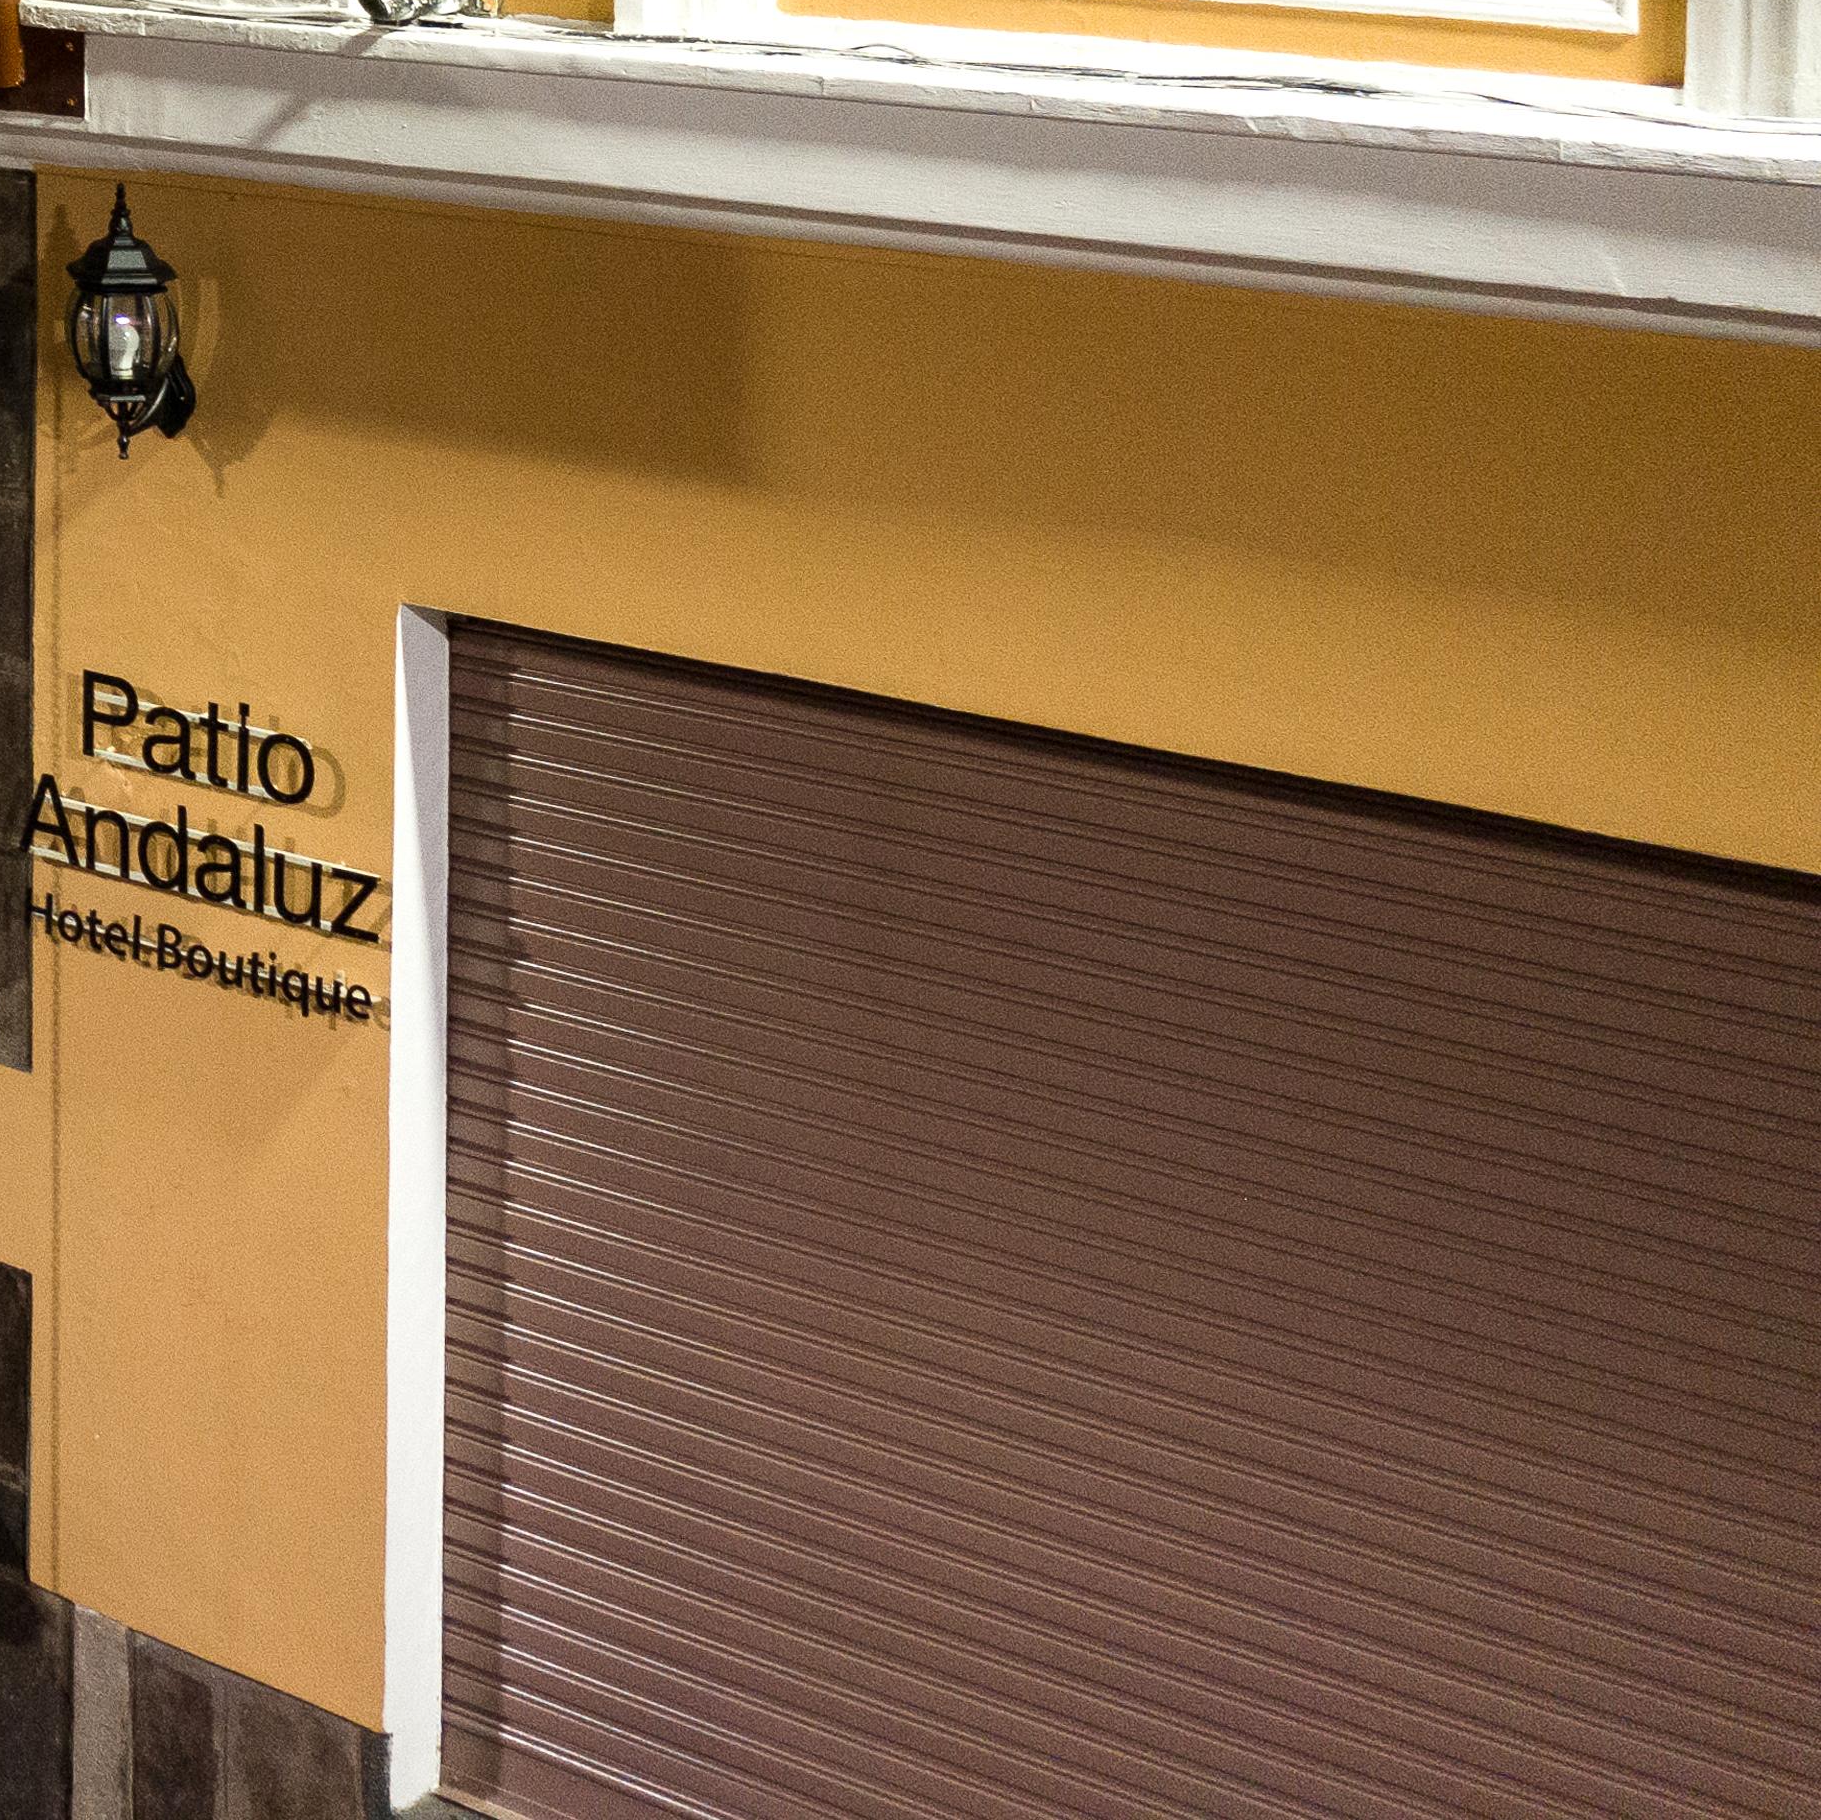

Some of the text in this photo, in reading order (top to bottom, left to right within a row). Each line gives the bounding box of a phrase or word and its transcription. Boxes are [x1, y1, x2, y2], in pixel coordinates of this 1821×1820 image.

[81, 669, 315, 805] Patio
[19, 773, 380, 943] Andaluz
[26, 888, 374, 1019] Hotel Boutique
